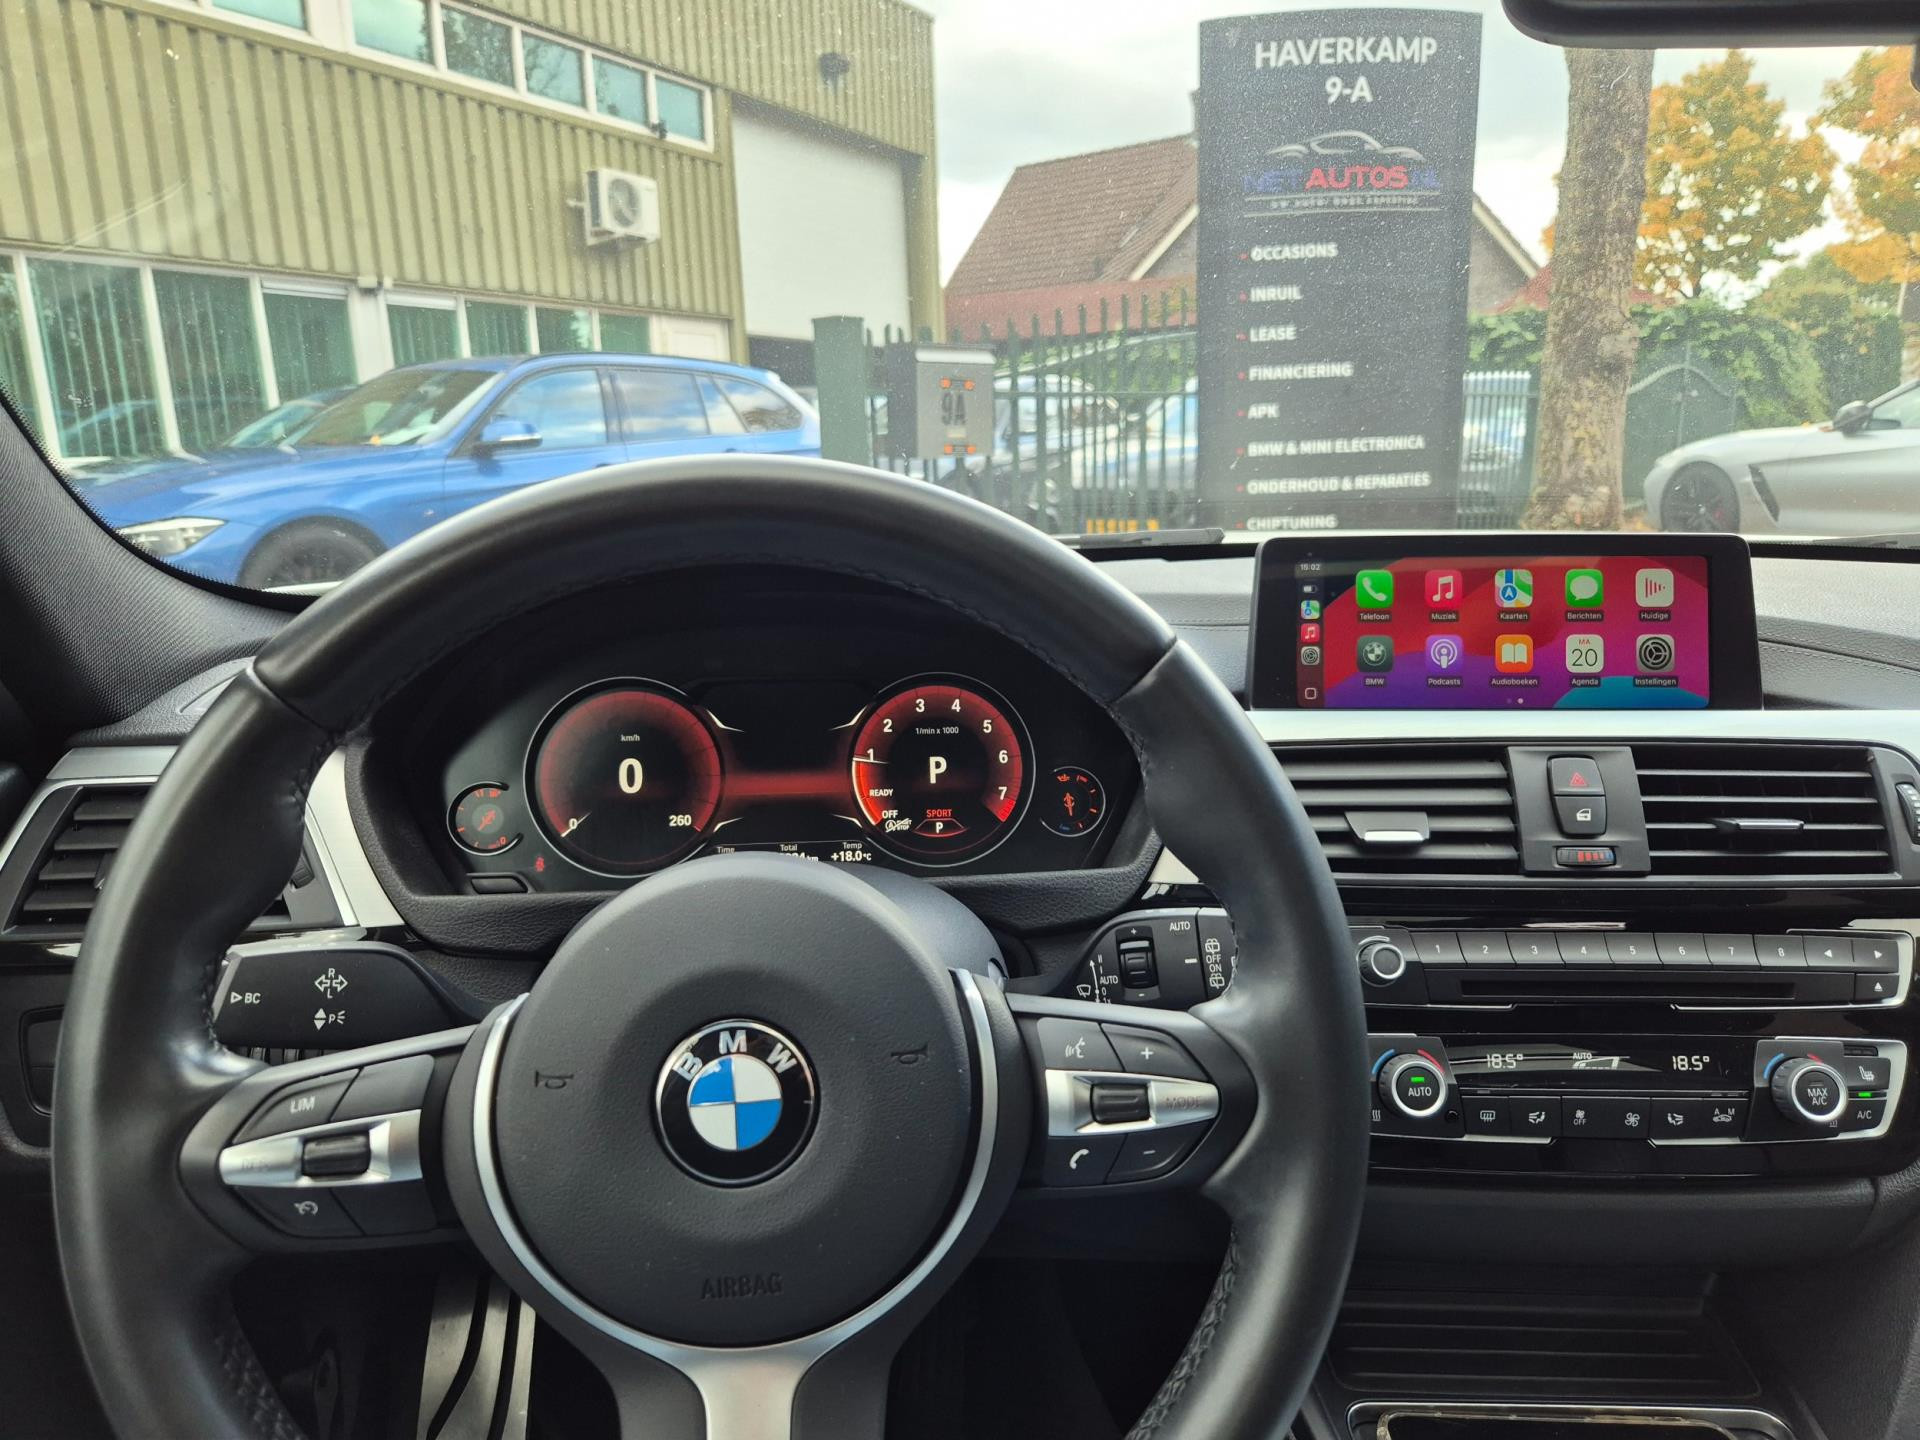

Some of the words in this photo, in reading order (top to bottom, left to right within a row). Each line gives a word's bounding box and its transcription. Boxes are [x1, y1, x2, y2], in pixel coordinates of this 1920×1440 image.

[1255, 36, 1437, 69] HAVERKAMP
[1325, 76, 1373, 103] 9-A
[1304, 165, 1409, 192] AUTOS
[1251, 242, 1338, 261] OCCASIONS
[1250, 285, 1302, 302] INRUIL
[1250, 324, 1297, 342] LEASE
[1249, 361, 1354, 381] FINANCIERING
[1248, 403, 1280, 419] APK
[1248, 441, 1285, 457] BMW
[1301, 439, 1333, 455] MINI
[1335, 434, 1426, 454] ELECTRONICA
[1247, 476, 1340, 495] ONDERHOUD
[1341, 474, 1354, 491] &
[1355, 471, 1432, 490] REPARATIES
[1247, 514, 1338, 531] CHIPTUNING
[1360, 612, 1389, 620] Telefoon
[1431, 612, 1457, 620] Muziek
[1500, 612, 1528, 620] Kaarten
[1567, 611, 1602, 620] Berichten
[1641, 611, 1669, 621] Huidige
[1571, 648, 1598, 667] 20
[1365, 678, 1384, 686] BMW
[1428, 677, 1461, 686] Podcasts
[1491, 677, 1538, 686] Audioboeken
[1571, 678, 1598, 687] Agenda
[1635, 677, 1677, 687] Instellingen
[915, 698, 925, 712] 3
[951, 698, 961, 712] 4
[883, 719, 893, 733] 2
[915, 727, 935, 735] 1/min
[942, 726, 959, 734] 1000
[983, 719, 993, 733] 5
[620, 734, 640, 742] km/h
[866, 749, 875, 762] 1
[999, 750, 1008, 764] 6
[929, 756, 947, 784] P
[618, 758, 643, 794] 0
[869, 788, 893, 797] READY
[998, 786, 1007, 800] 7
[882, 809, 898, 819] OFF
[926, 809, 952, 817] SPORT
[569, 818, 578, 830] 0
[669, 815, 691, 827] 260
[935, 822, 944, 833] P
[717, 846, 735, 854] Time
[780, 844, 798, 852] Total
[843, 842, 862, 850] Temp
[1169, 921, 1191, 932] AUTO
[1435, 945, 1441, 954] 1
[1482, 945, 1489, 955] 2
[1531, 945, 1538, 955] 3
[1580, 945, 1587, 955] 4
[1629, 945, 1636, 955] 5
[1678, 946, 1685, 956] 6
[1728, 946, 1734, 956] 7
[1778, 947, 1785, 957] 8
[1206, 954, 1222, 964] OFF
[328, 967, 336, 978] R
[1209, 964, 1222, 973] ON
[1100, 975, 1119, 985] AUTO
[244, 992, 261, 1004] BC
[327, 989, 333, 999] L
[671, 1029, 798, 1082] BMW
[1572, 1052, 1592, 1060] AUTO
[1408, 1087, 1432, 1097] AUTO
[1807, 1088, 1828, 1098] MAX
[290, 1096, 316, 1114] LIM
[1812, 1096, 1828, 1106] A/C
[1857, 1109, 1873, 1119] A/C
[1573, 1117, 1587, 1125] OFF
[700, 1272, 782, 1300] AIRBAG
